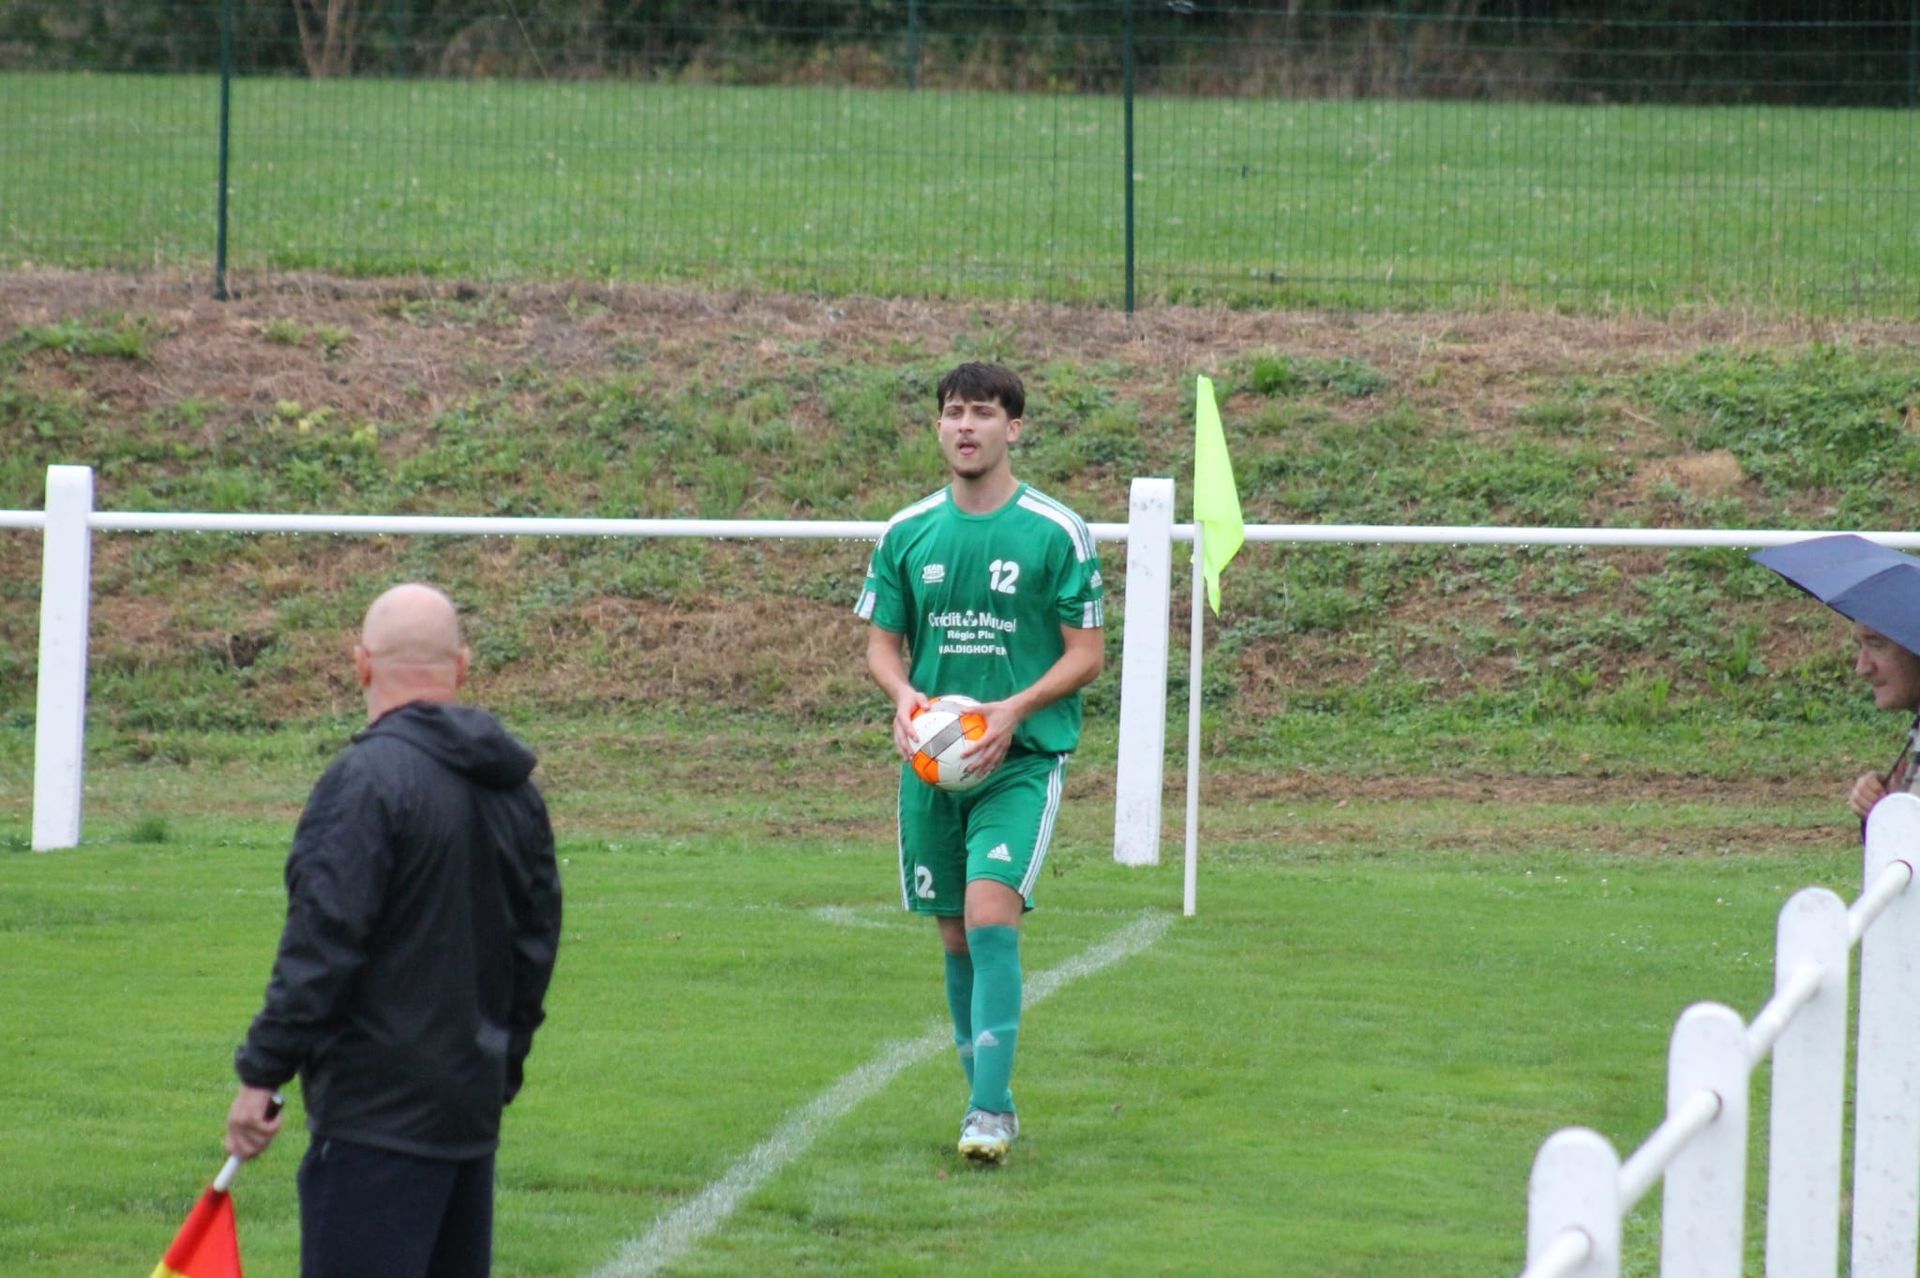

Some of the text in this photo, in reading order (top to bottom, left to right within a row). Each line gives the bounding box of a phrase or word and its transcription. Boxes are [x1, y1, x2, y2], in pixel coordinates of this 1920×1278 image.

[989, 559, 1020, 594] 12
[947, 630, 995, 641] Régio Plu
[914, 863, 936, 899] 2
